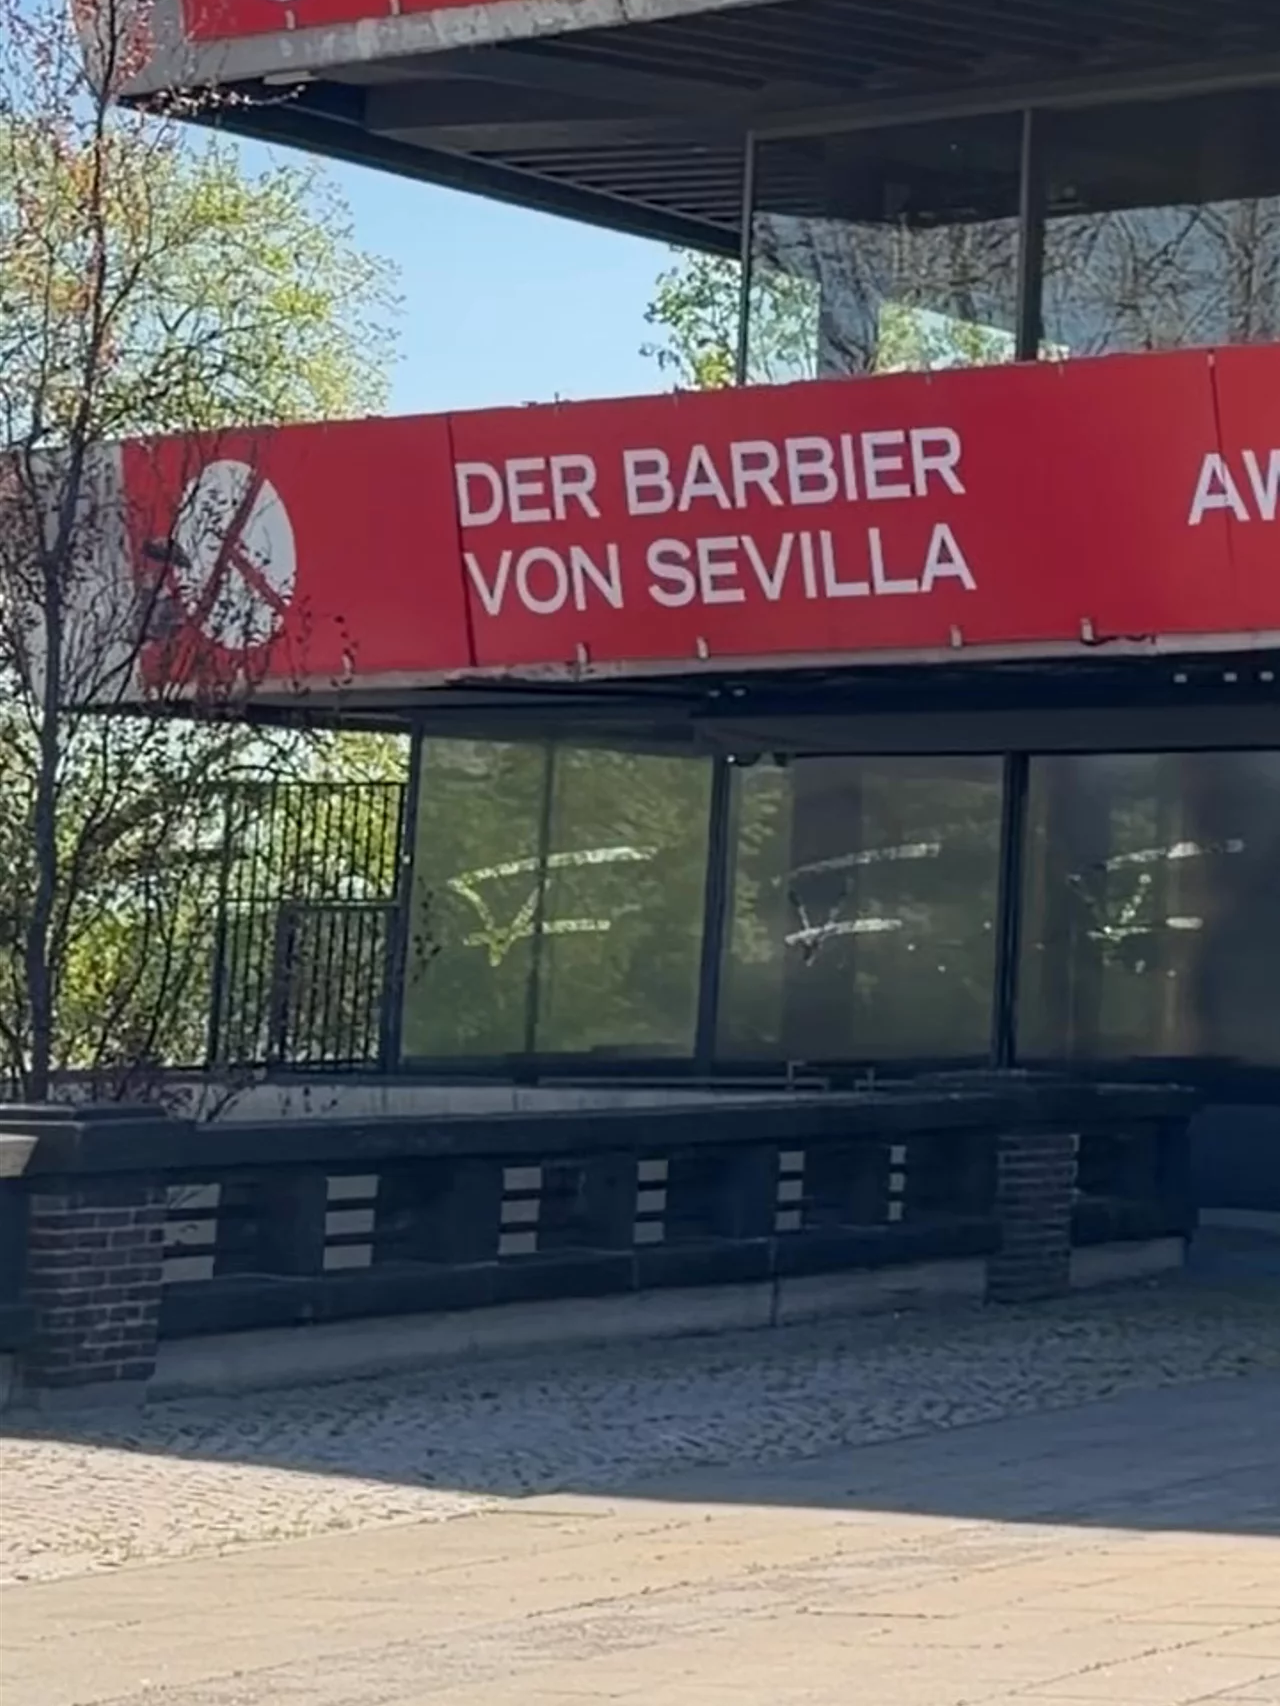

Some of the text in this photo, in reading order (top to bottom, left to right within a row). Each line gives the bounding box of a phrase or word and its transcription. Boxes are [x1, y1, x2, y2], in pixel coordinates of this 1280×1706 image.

[455, 427, 965, 526] DER BARBIER
[464, 524, 976, 615] VON SEVILLA
